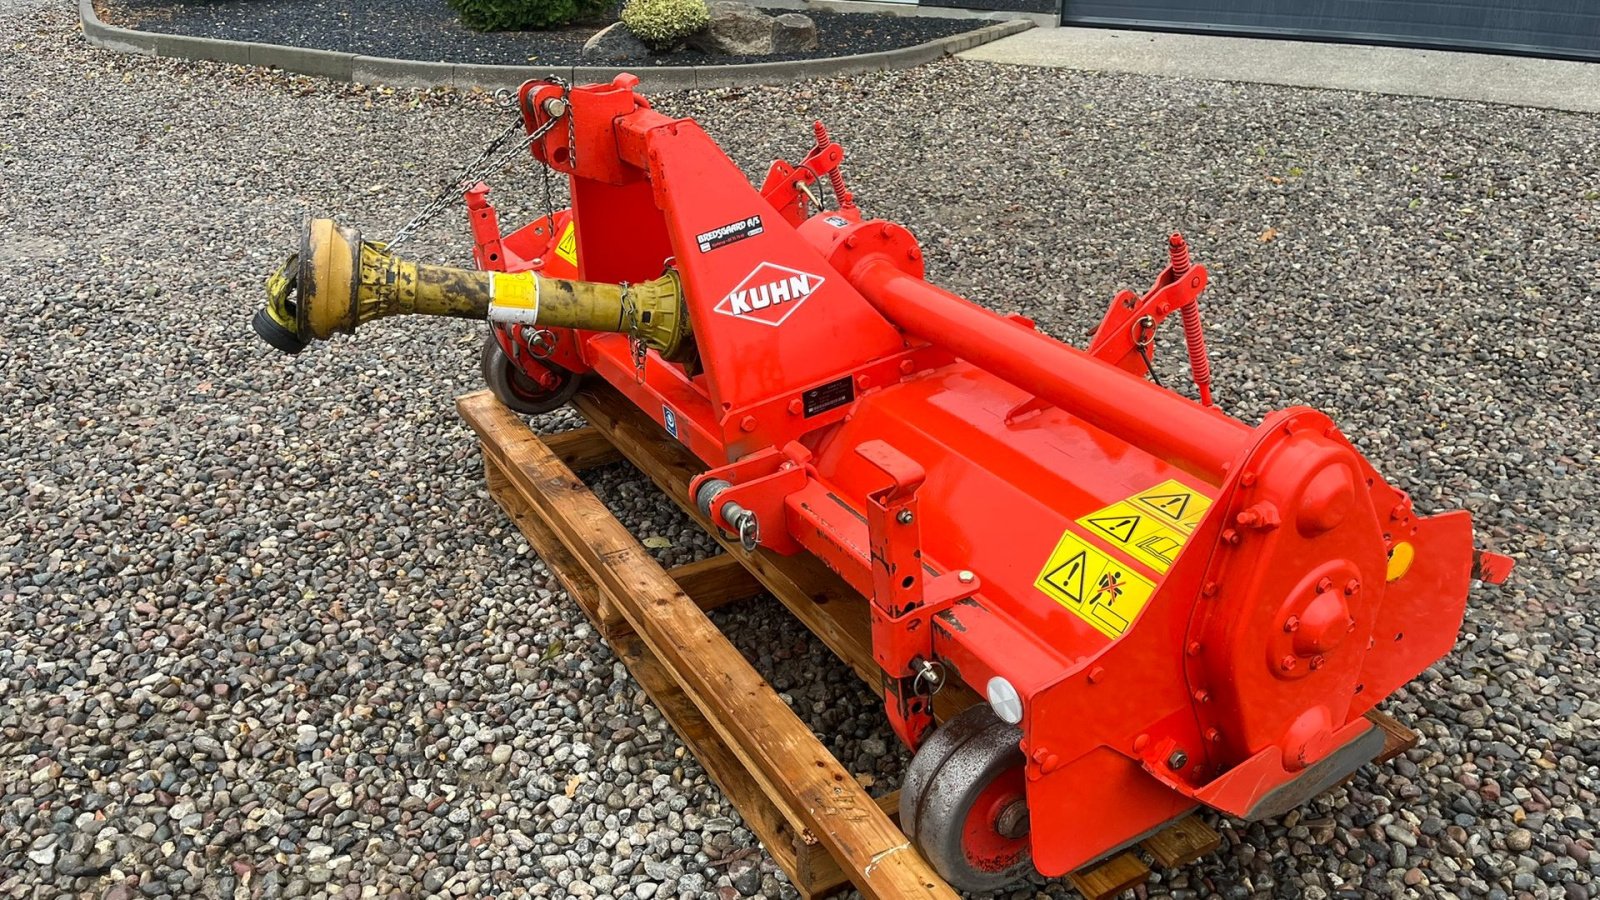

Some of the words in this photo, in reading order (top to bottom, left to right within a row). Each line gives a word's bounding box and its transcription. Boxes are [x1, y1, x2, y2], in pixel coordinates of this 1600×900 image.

[697, 221, 746, 243] BREDSGAARD
[746, 216, 760, 228] A/S
[729, 274, 811, 315] KUHN
